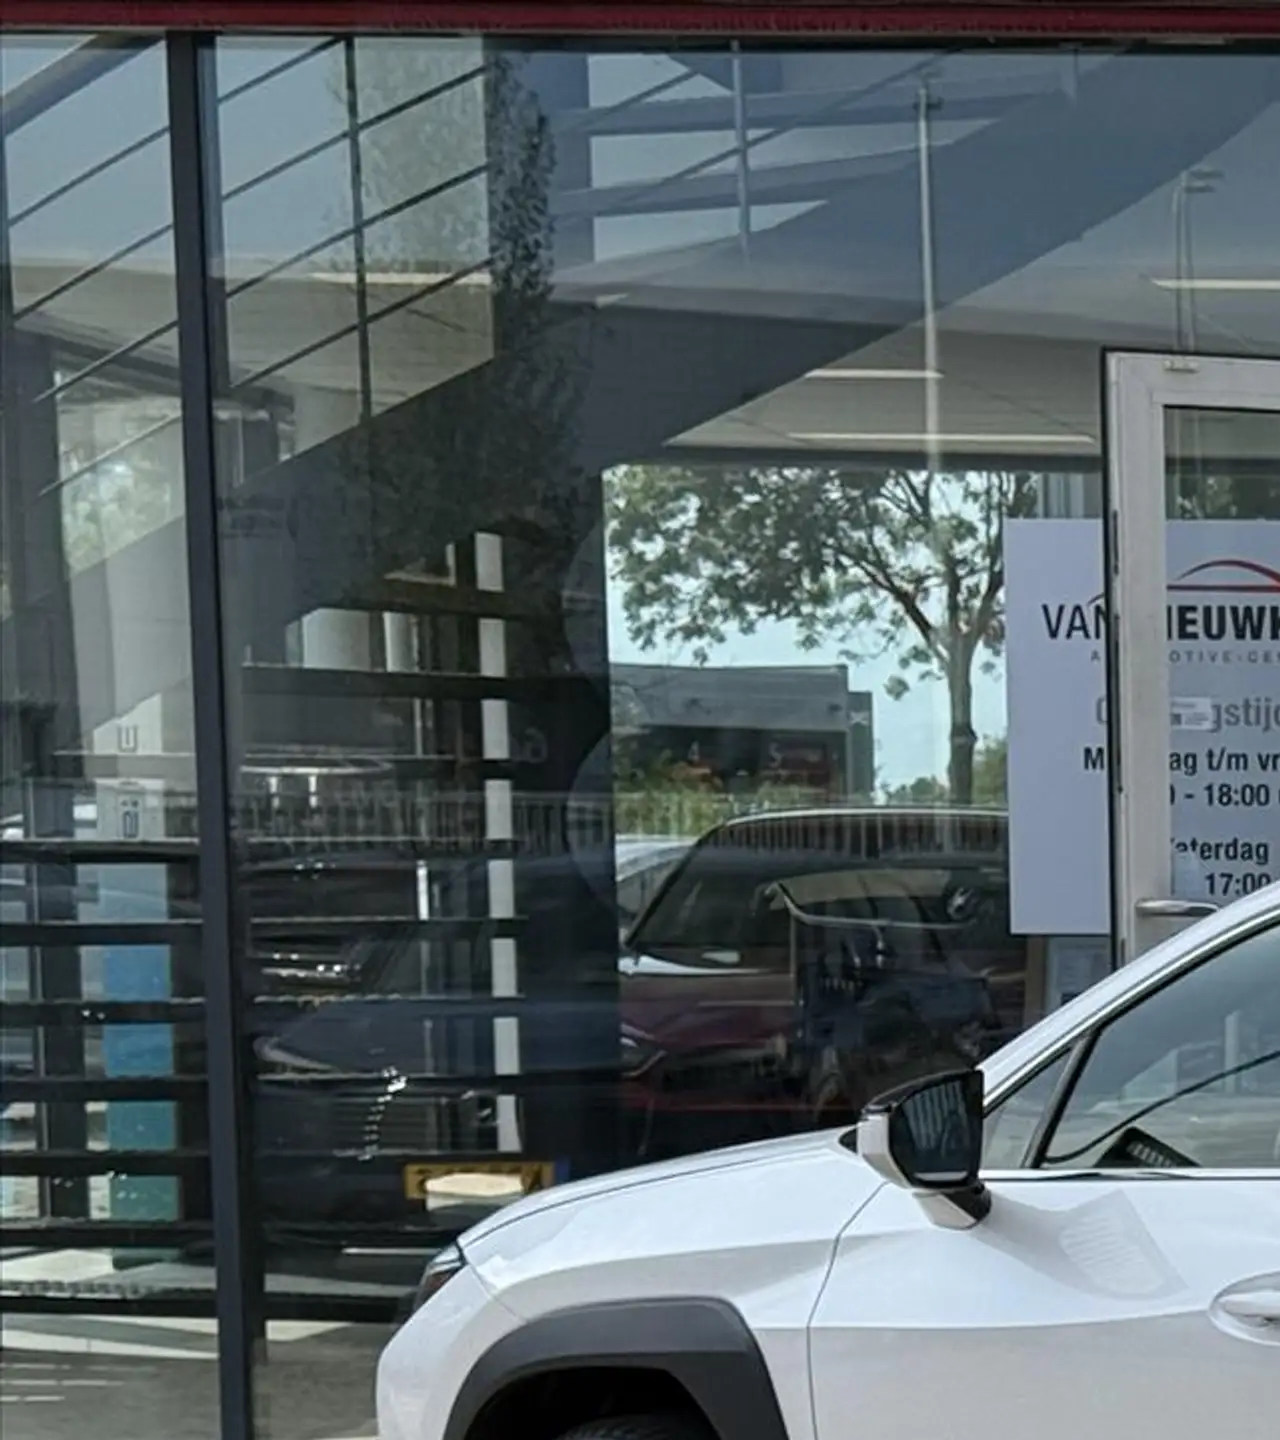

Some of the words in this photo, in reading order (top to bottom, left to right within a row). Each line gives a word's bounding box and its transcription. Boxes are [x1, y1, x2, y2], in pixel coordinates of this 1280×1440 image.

[1204, 745, 1250, 773] t/m
[1204, 783, 1271, 807] 18:00
[1169, 836, 1271, 867] aterdag
